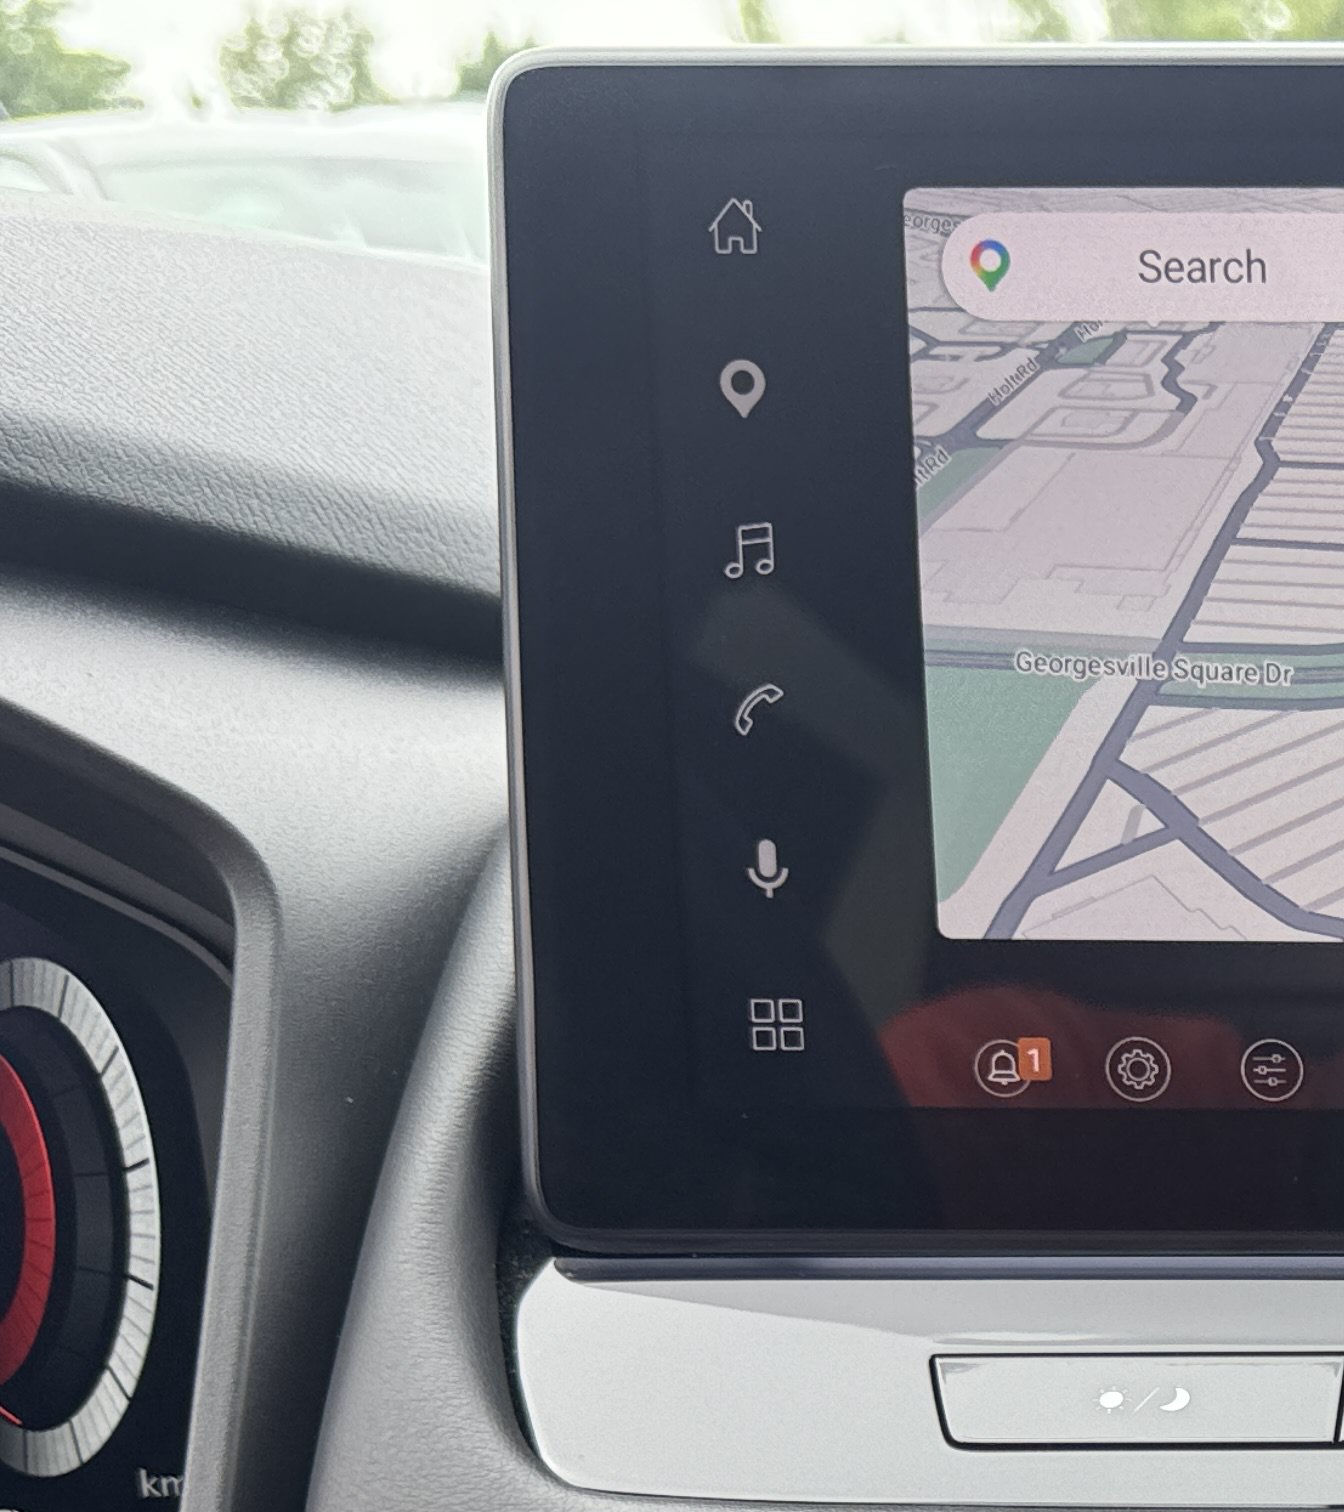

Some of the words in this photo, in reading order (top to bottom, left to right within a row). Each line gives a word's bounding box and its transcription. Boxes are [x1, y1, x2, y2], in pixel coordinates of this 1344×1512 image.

[1138, 248, 1267, 284] Search
[1015, 651, 1169, 680] Georgesville
[1173, 657, 1258, 684] Square
[1264, 661, 1293, 684] Dr
[1027, 1048, 1040, 1072] 1
